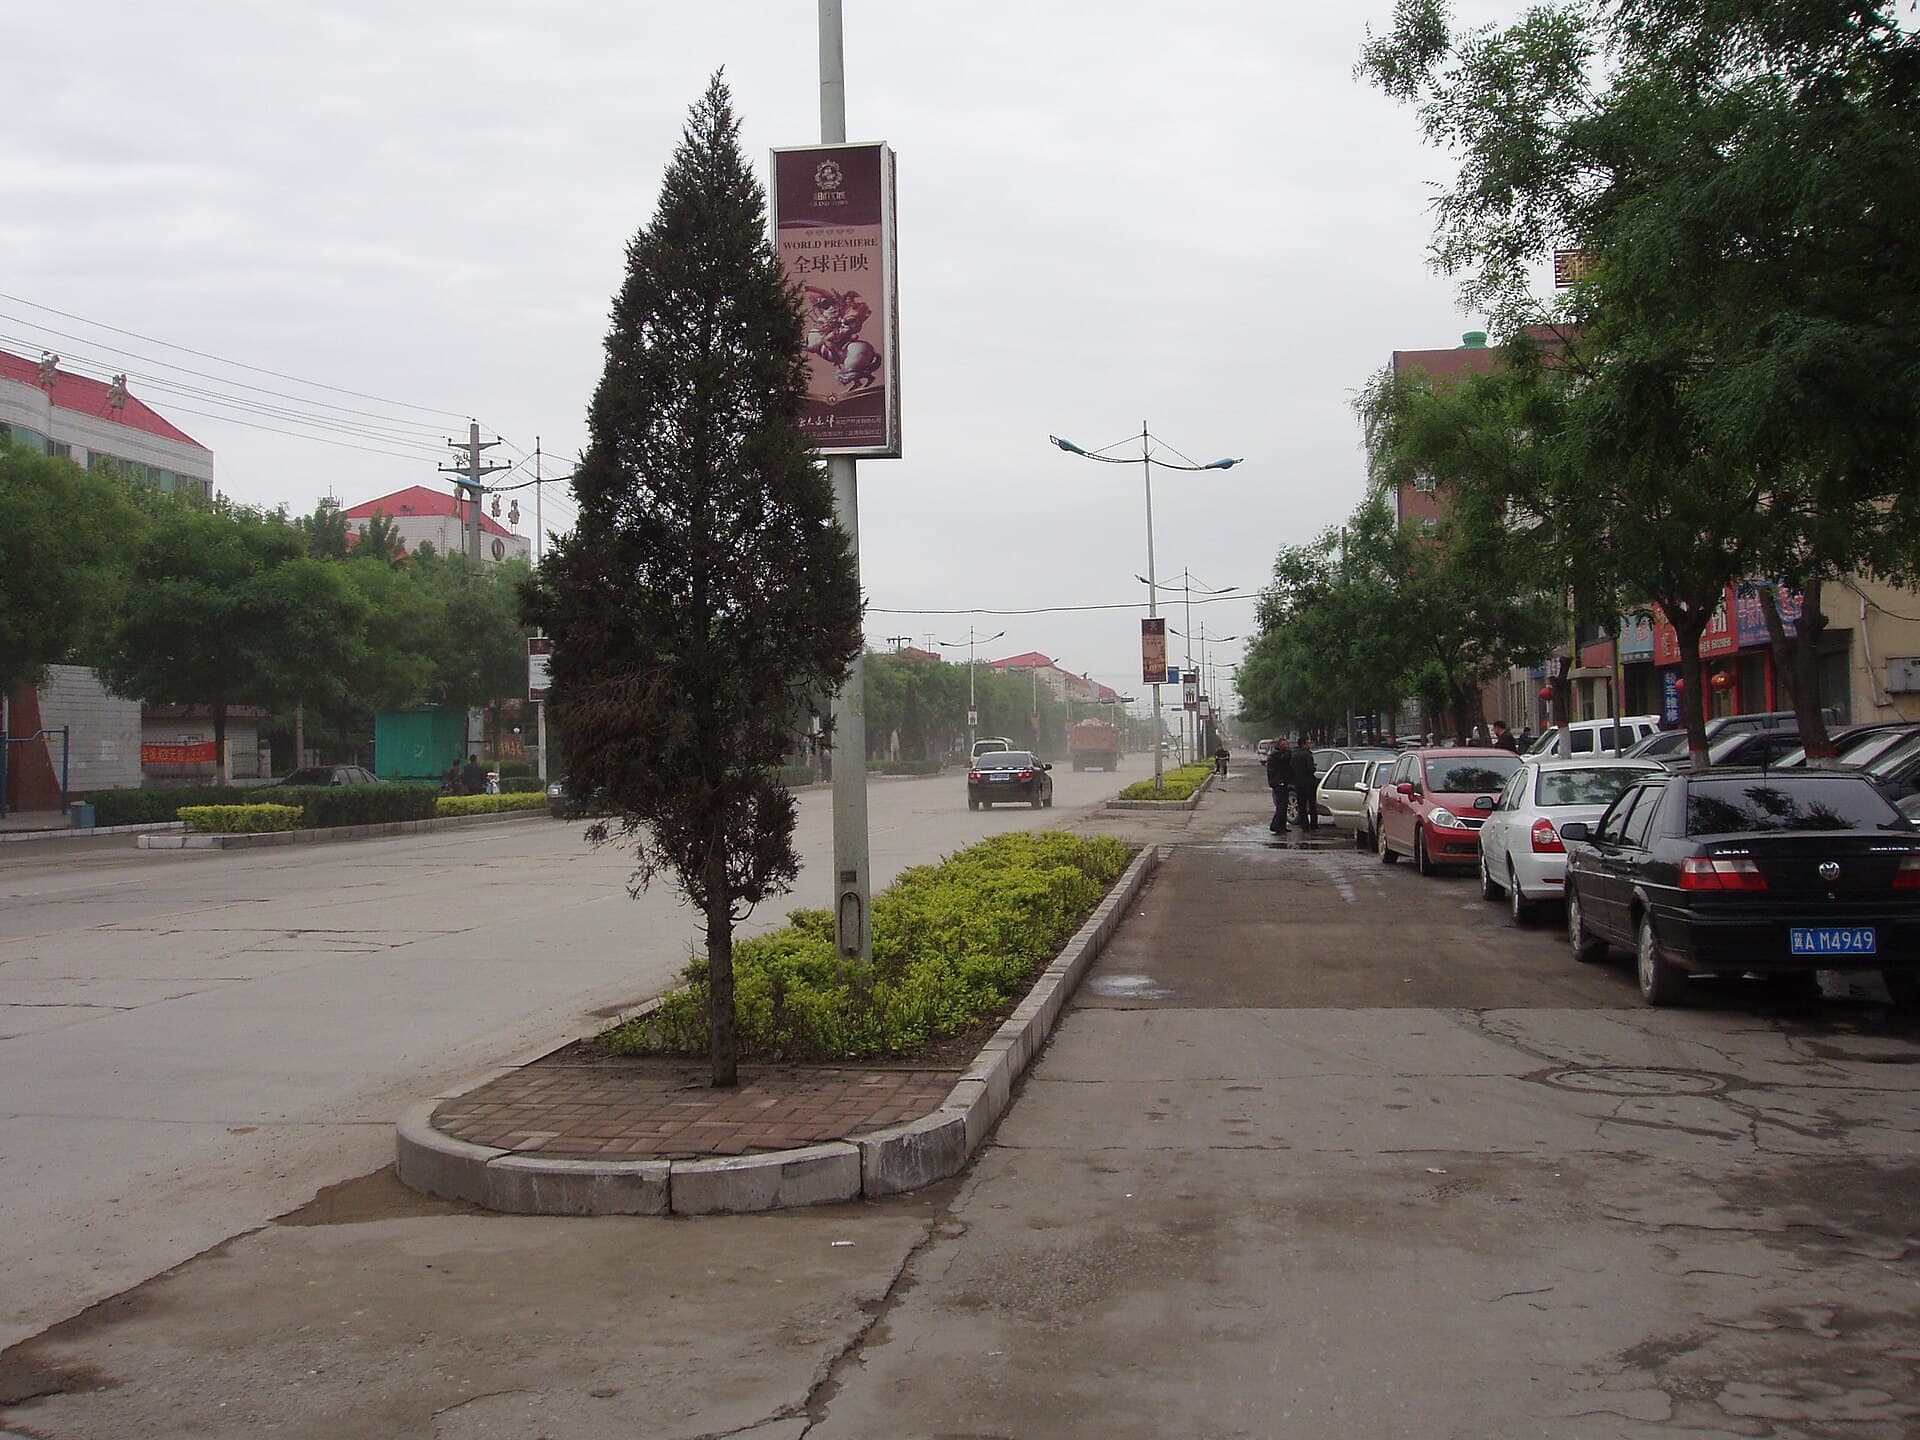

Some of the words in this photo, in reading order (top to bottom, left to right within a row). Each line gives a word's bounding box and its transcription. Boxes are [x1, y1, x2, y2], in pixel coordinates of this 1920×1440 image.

[784, 239, 822, 250] WORLD
[824, 238, 878, 249] PREMIERE
[793, 253, 869, 273] 全球首映
[1819, 931, 1873, 950] M4949
